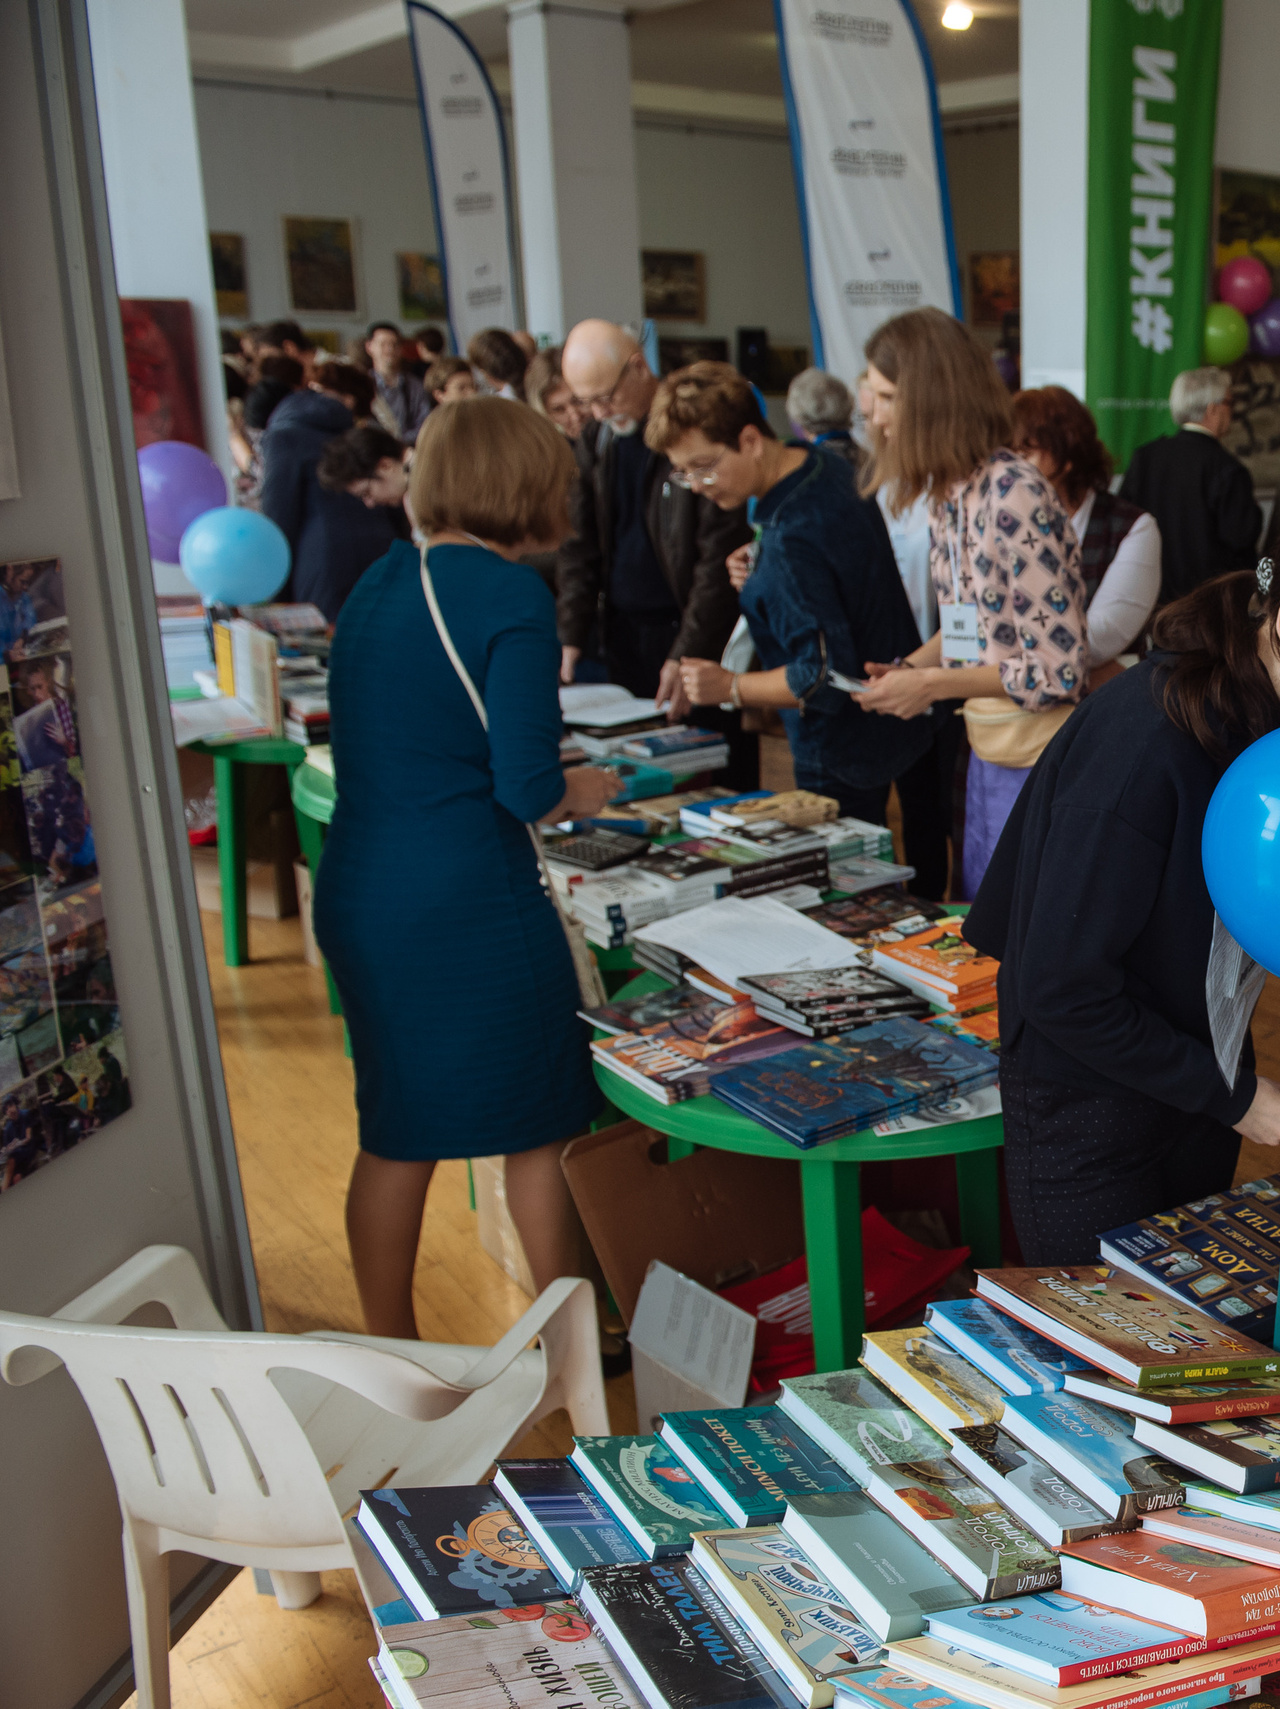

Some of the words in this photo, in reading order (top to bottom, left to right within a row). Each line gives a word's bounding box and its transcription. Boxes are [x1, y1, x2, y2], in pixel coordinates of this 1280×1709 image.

[1129, 45, 1177, 354] #КНИГИ
[1037, 1276, 1099, 1308] МИРА
[1097, 1312, 1177, 1355] ФЛАГИ
[1184, 1368, 1203, 1379] МИРА
[1204, 1366, 1229, 1377] ФЛАГИ
[1045, 1405, 1094, 1438] ГОРОД
[1061, 1400, 1113, 1437] СОЛНЦА
[702, 1417, 747, 1456] ПОКЕТ
[627, 1451, 645, 1487] МИЛЛИОН
[737, 1455, 785, 1502] МИМСИ
[642, 1484, 684, 1517] МАГНУС
[1042, 1477, 1094, 1514] ГОРОД
[1147, 1493, 1184, 1511] ОЛНЦА
[965, 1517, 1017, 1556] ГОРОД
[983, 1511, 1039, 1555] СОЛНЦА
[645, 1582, 667, 1613] Крюс
[751, 1578, 778, 1608] Кестнер
[660, 1604, 695, 1647] Джеймс
[704, 1593, 761, 1657] Проданный
[776, 1608, 795, 1628] Эрих
[1030, 1613, 1131, 1649] ОТПРАВЛЯЕТСЯ
[1244, 1606, 1262, 1623] ТАМ
[1256, 1624, 1276, 1634] Маркус
[692, 1622, 735, 1666] ТИМ
[810, 1610, 879, 1654] Мальчик
[1069, 1638, 1111, 1653] БОБО
[1183, 1640, 1208, 1654] БОБО
[1217, 1628, 1256, 1644] ОСТЕРВАЛЬДЕР
[522, 1645, 577, 1698] ЖИЗНЬ
[1080, 1659, 1115, 1679] ГУЛЯТЬ
[1115, 1645, 1183, 1670] ОТПРАВЛЯЕТСЯ
[1157, 1677, 1207, 1695] маленького
[1208, 1671, 1225, 1683] Про
